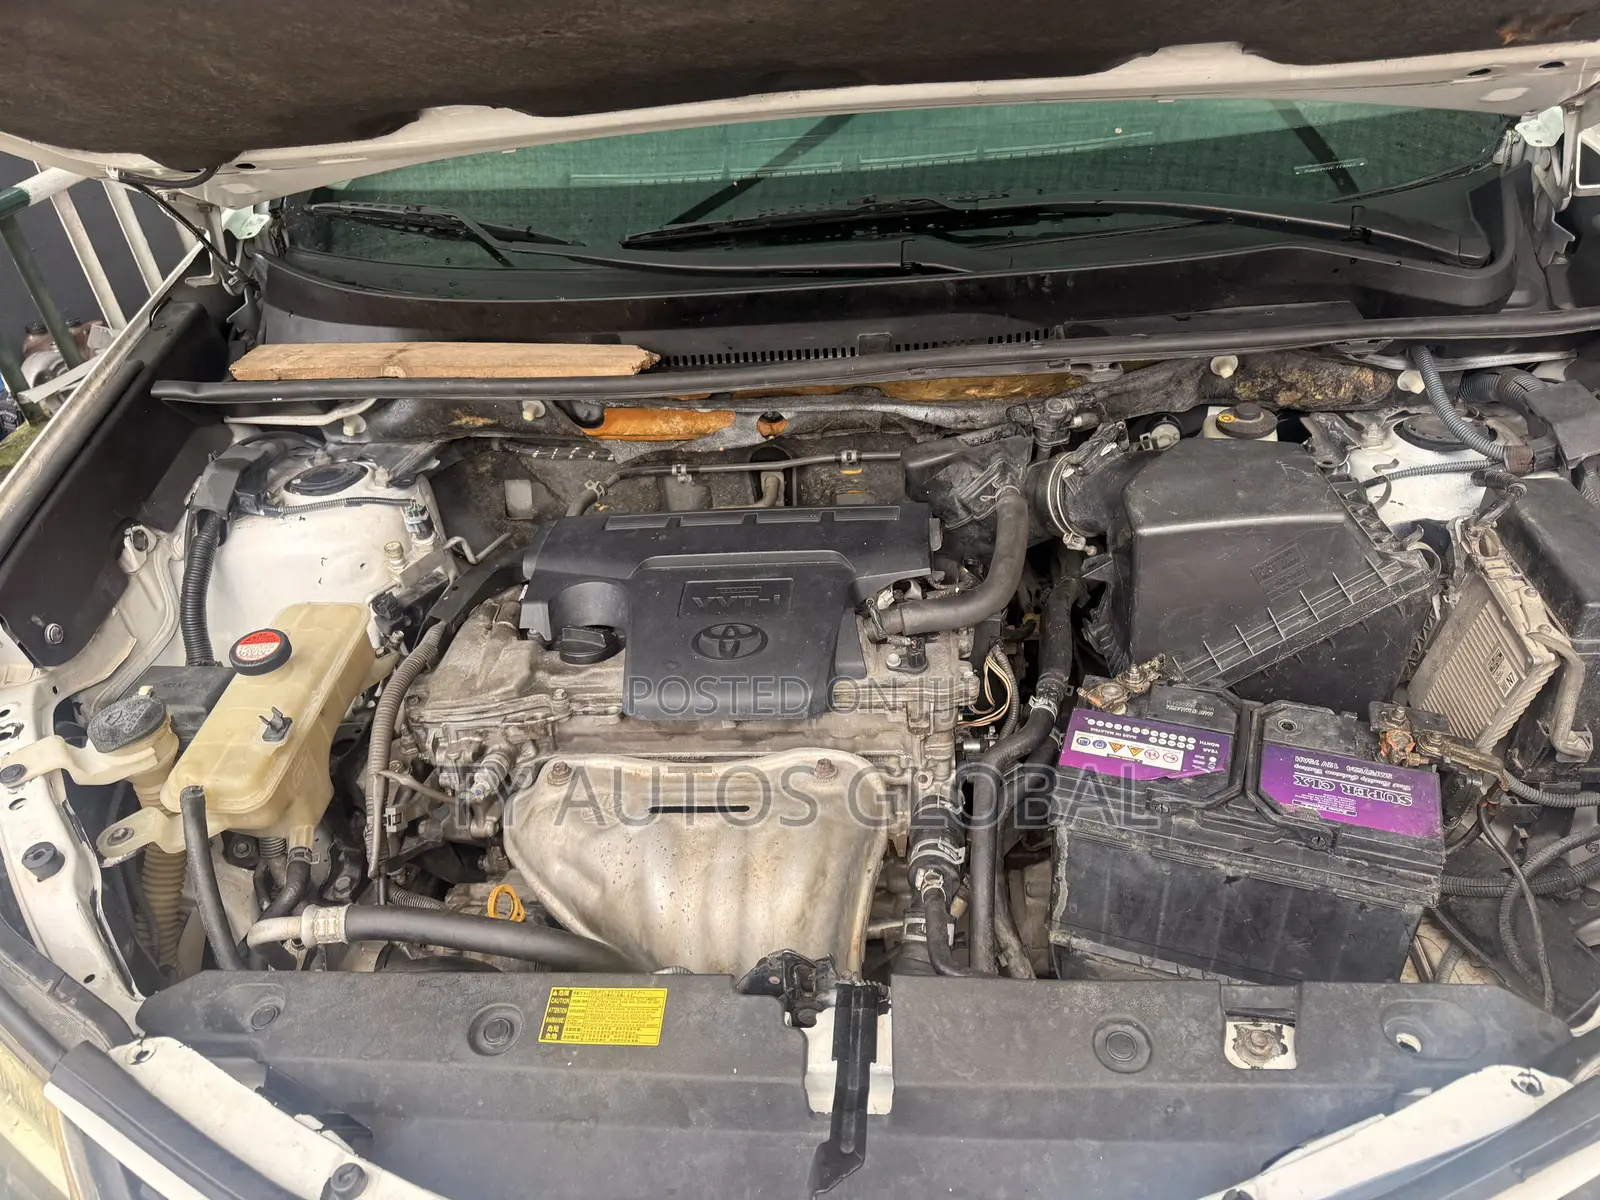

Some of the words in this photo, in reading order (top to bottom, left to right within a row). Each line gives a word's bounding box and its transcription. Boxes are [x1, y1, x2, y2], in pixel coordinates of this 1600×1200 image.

[1199, 740, 1220, 748] MONTH
[1202, 747, 1219, 755] YEAR
[1293, 763, 1323, 774] Battery
[1325, 769, 1360, 781] Calcium
[1360, 775, 1391, 787] Quality
[1293, 774, 1336, 791] CLX
[1340, 783, 1413, 806] SUPER
